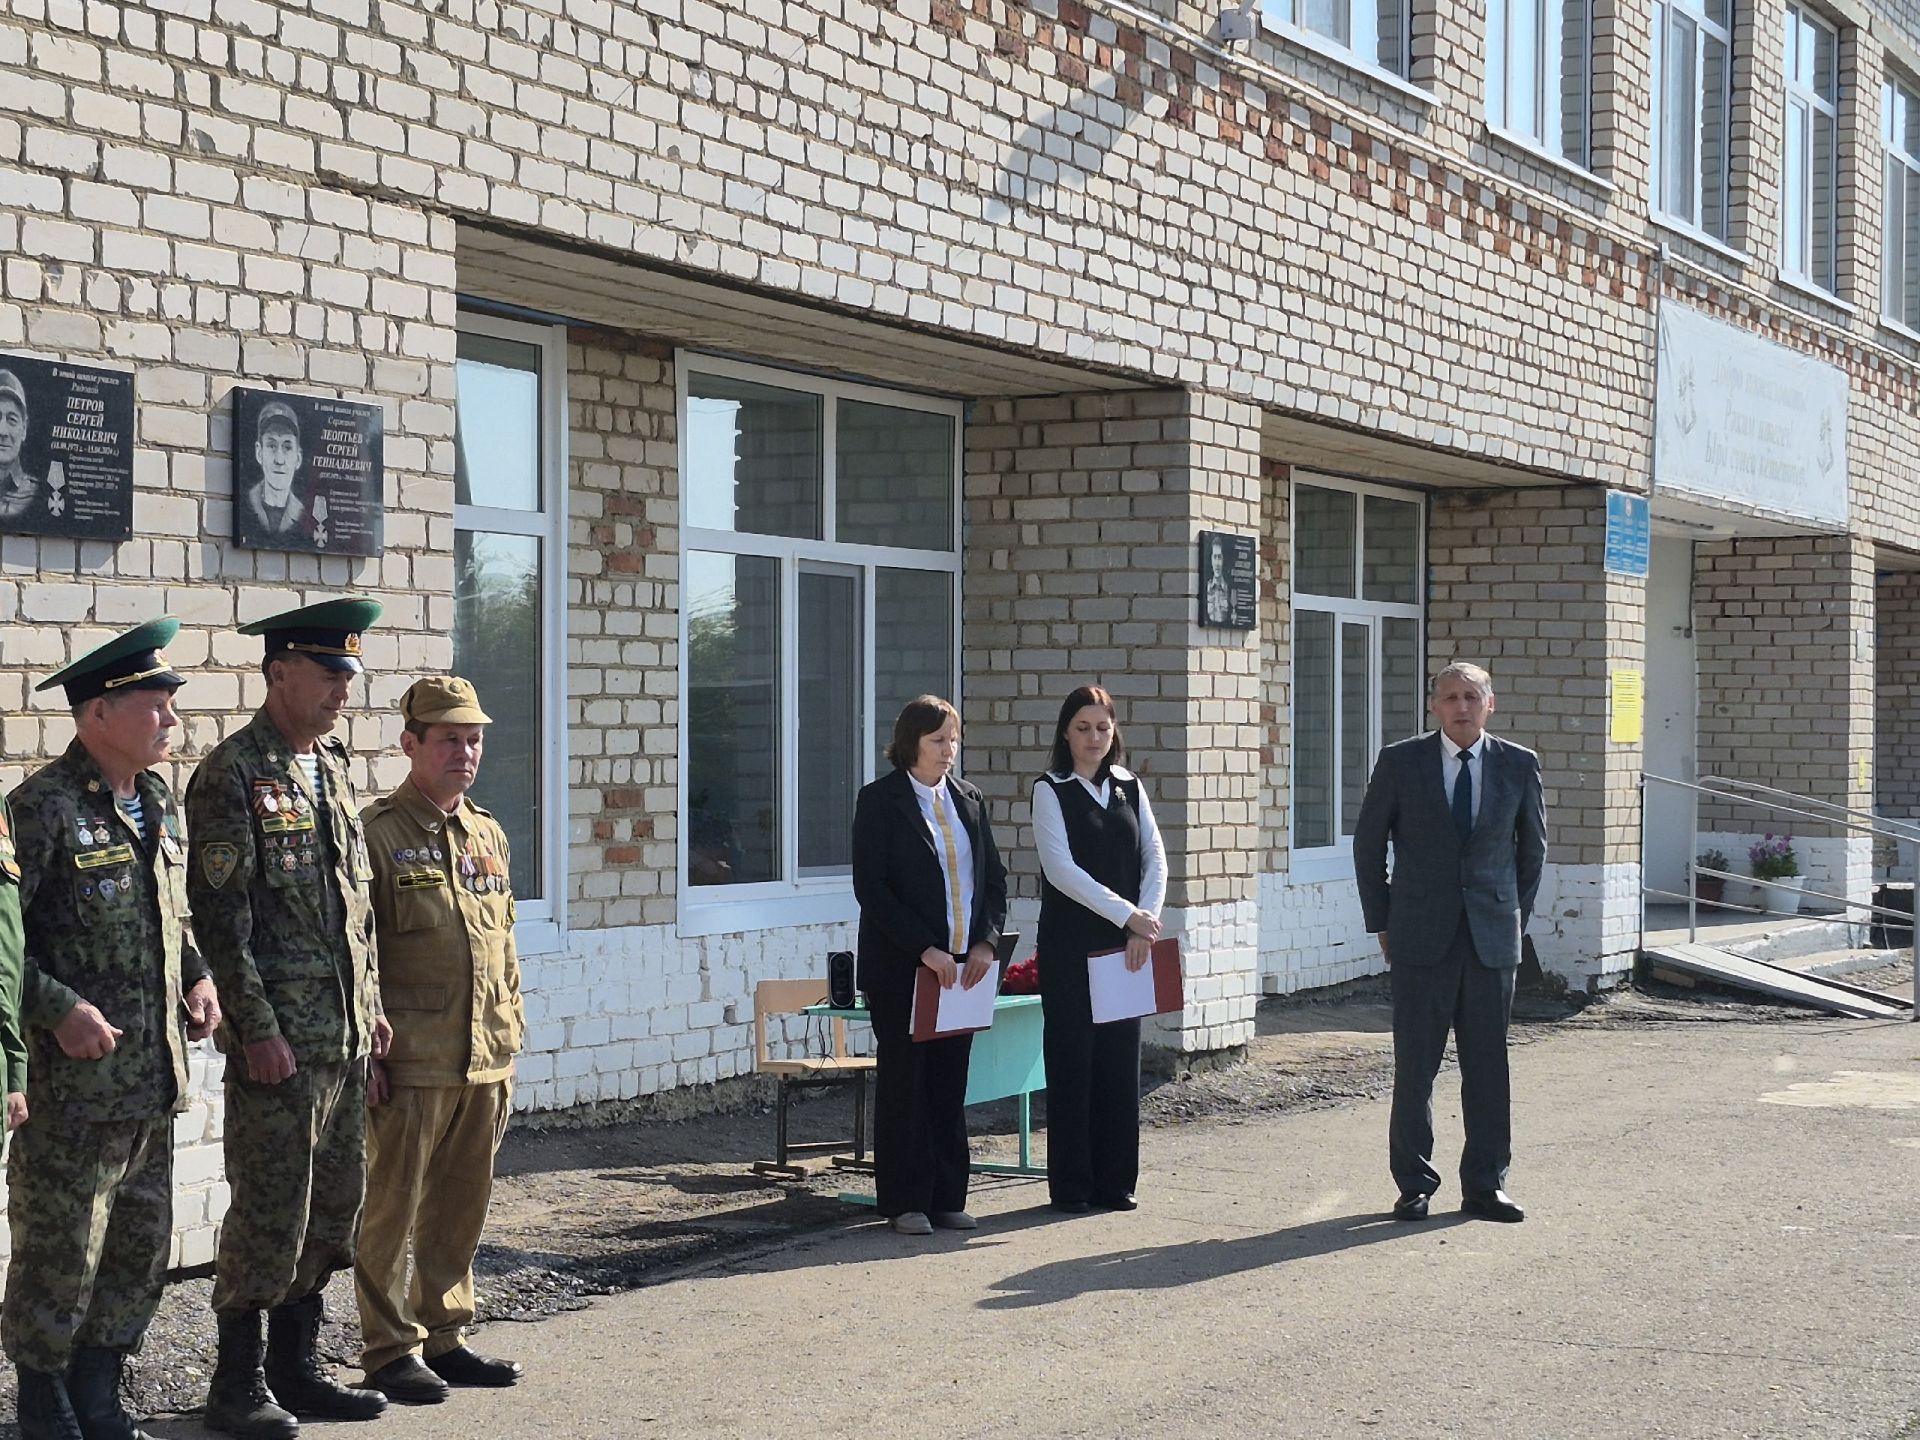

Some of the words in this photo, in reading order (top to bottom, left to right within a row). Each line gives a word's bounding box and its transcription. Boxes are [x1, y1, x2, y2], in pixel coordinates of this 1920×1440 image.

[67, 396, 104, 412] ПЕТРОВ
[67, 412, 104, 427] СЕРГЕЙ
[52, 425, 118, 444] НИКОЛАЕВИЧ
[320, 429, 363, 444] ЛЕОНТЬЕВ
[326, 443, 358, 457] СЕРГЕЙ
[312, 455, 372, 472] ГЕННАДЬЕВИЧ
